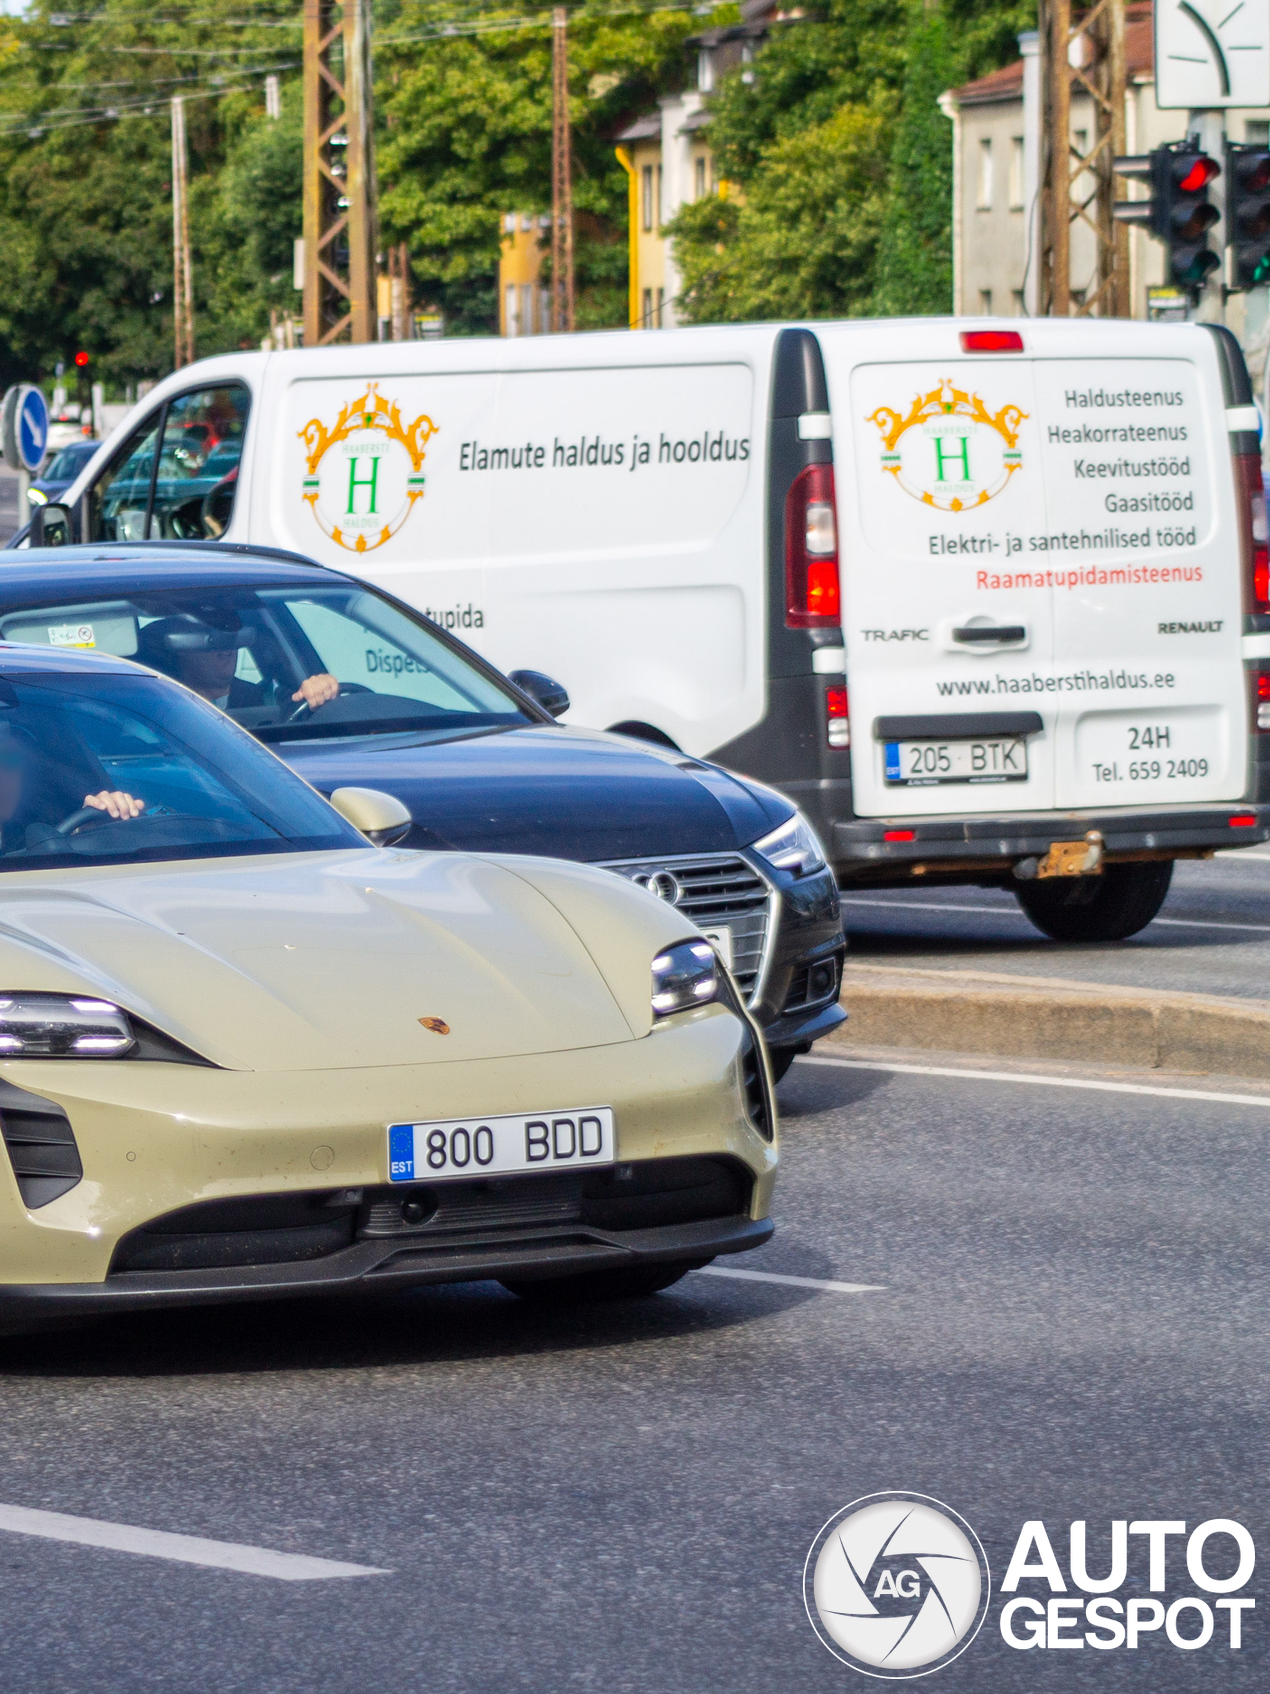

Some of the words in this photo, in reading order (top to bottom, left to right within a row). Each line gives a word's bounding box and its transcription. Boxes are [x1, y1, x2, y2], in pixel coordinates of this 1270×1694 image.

[1065, 388, 1183, 408] Haldusteenus
[1047, 423, 1187, 443] Heakorrateenus
[341, 442, 389, 454] HAABERSTI
[459, 440, 545, 471] Elamute
[552, 435, 624, 467] haldus
[630, 434, 650, 472] ja
[658, 430, 750, 463] hooldus
[929, 437, 975, 481] H
[1074, 456, 1191, 478] Keevitustööd
[344, 457, 382, 514] H
[1104, 491, 1194, 513] Gaasitööd
[343, 518, 379, 528] HALDUS
[929, 534, 1000, 554] Elektri-
[1005, 532, 1022, 556] ja
[1029, 527, 1151, 552] santehnilised
[1156, 526, 1196, 547] tööd
[976, 564, 1203, 590] Raamatupidamisteenus
[861, 629, 929, 641] TRAFIC
[1158, 621, 1223, 634] RENAULT
[937, 669, 1175, 696] www.haaberstihaldus.ee
[1128, 726, 1171, 750] 24H
[909, 746, 951, 773] 205
[971, 741, 1018, 771] BTK
[1092, 762, 1123, 782] Tel.
[1129, 760, 1161, 780] 659
[1166, 758, 1208, 778] 2409
[426, 1125, 494, 1169] 800
[524, 1116, 603, 1163] BDD
[391, 1161, 413, 1174] EST
